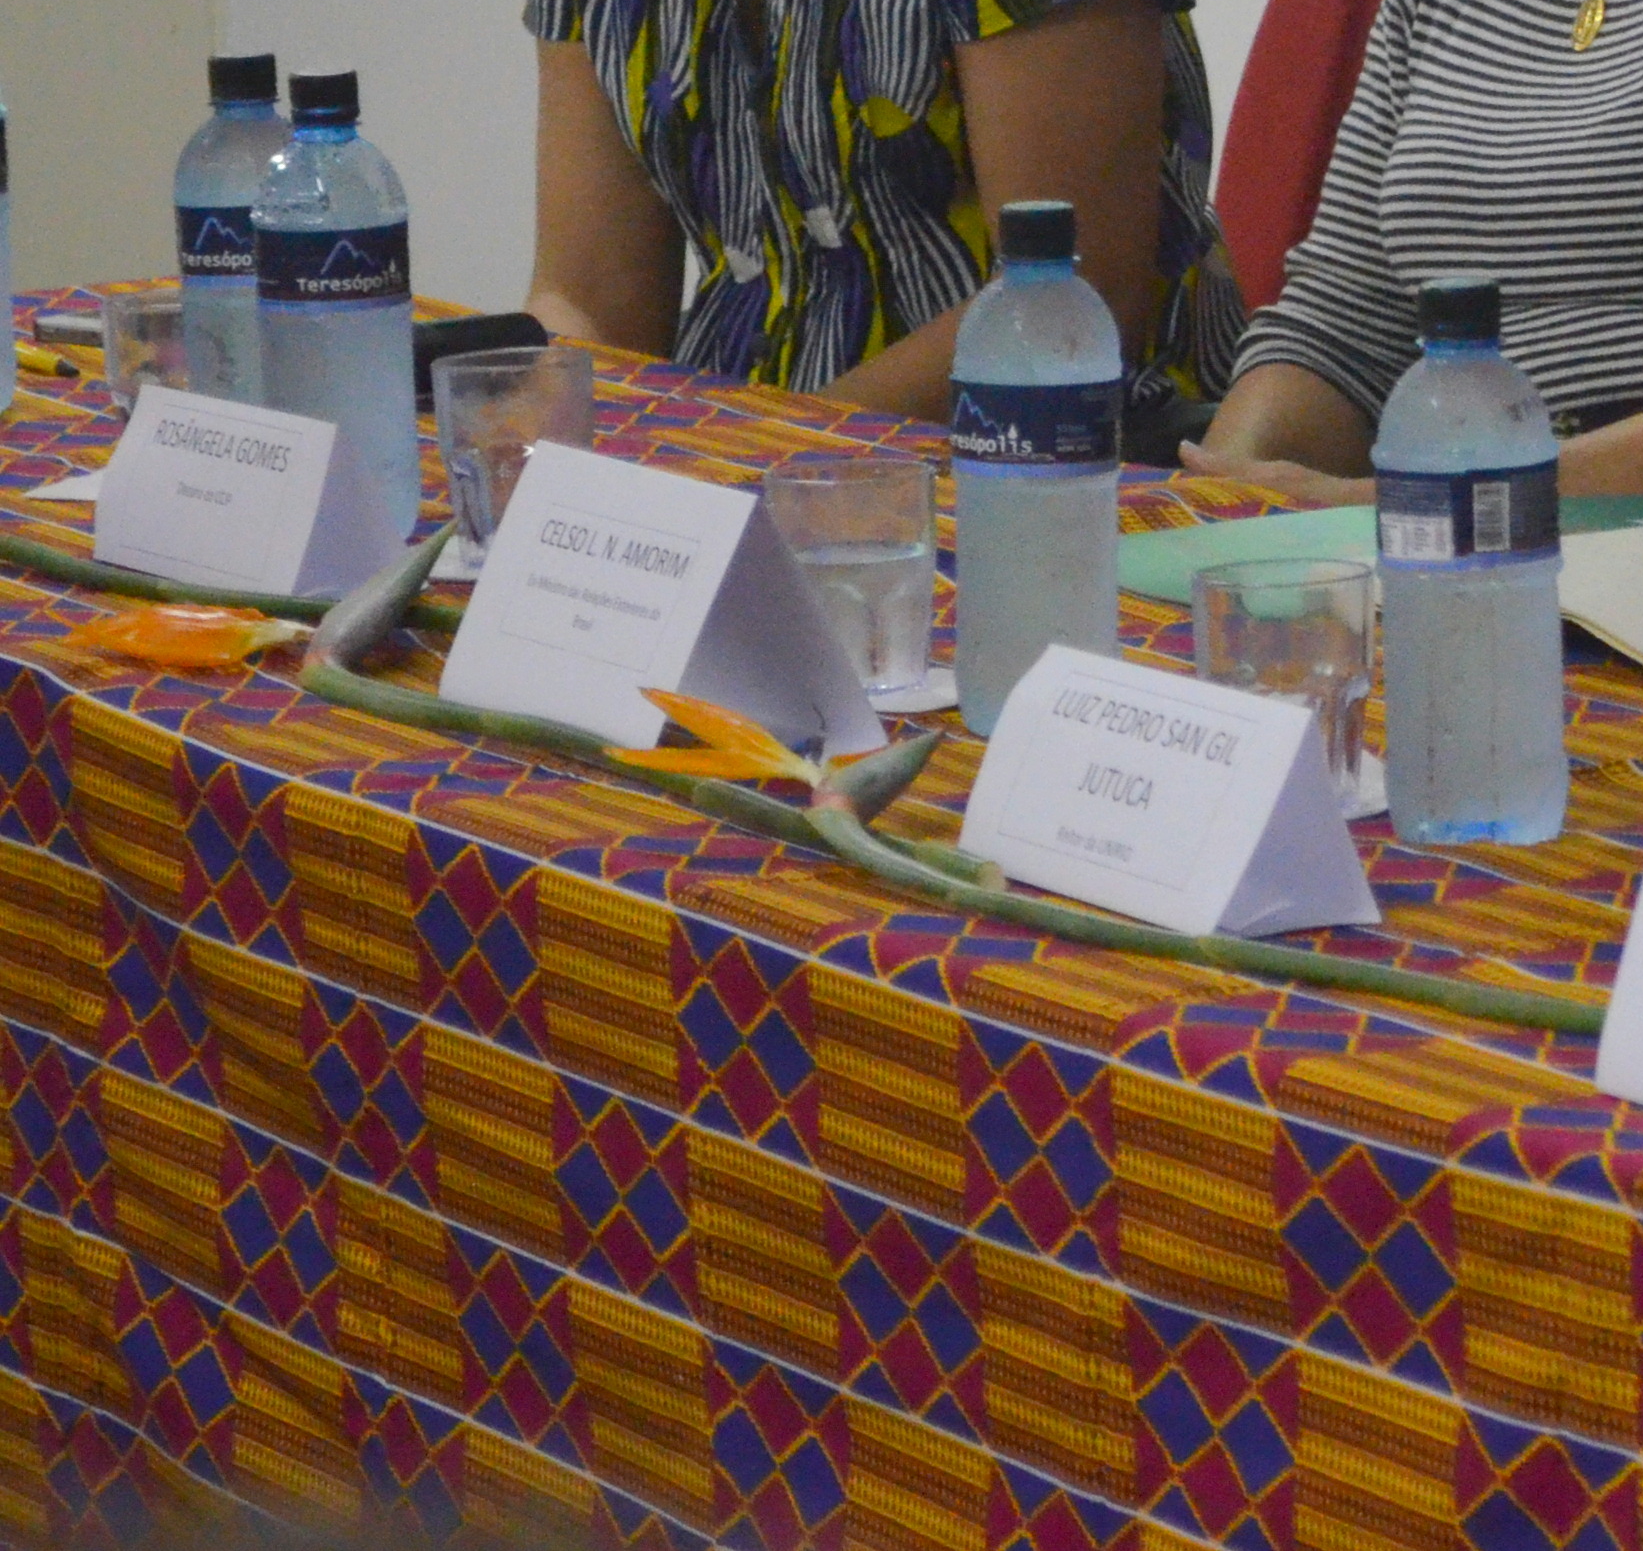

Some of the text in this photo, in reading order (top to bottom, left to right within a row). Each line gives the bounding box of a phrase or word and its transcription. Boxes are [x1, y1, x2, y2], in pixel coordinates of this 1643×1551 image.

[181, 250, 255, 270] Teresópo
[236, 437, 291, 473] GOMES
[540, 519, 588, 552] CELSO
[601, 534, 619, 561] N.
[618, 540, 690, 579] AMORIM
[1052, 688, 1240, 766] LUIZ PEDRO SAN GIL
[1078, 763, 1154, 810] JUTUCA
